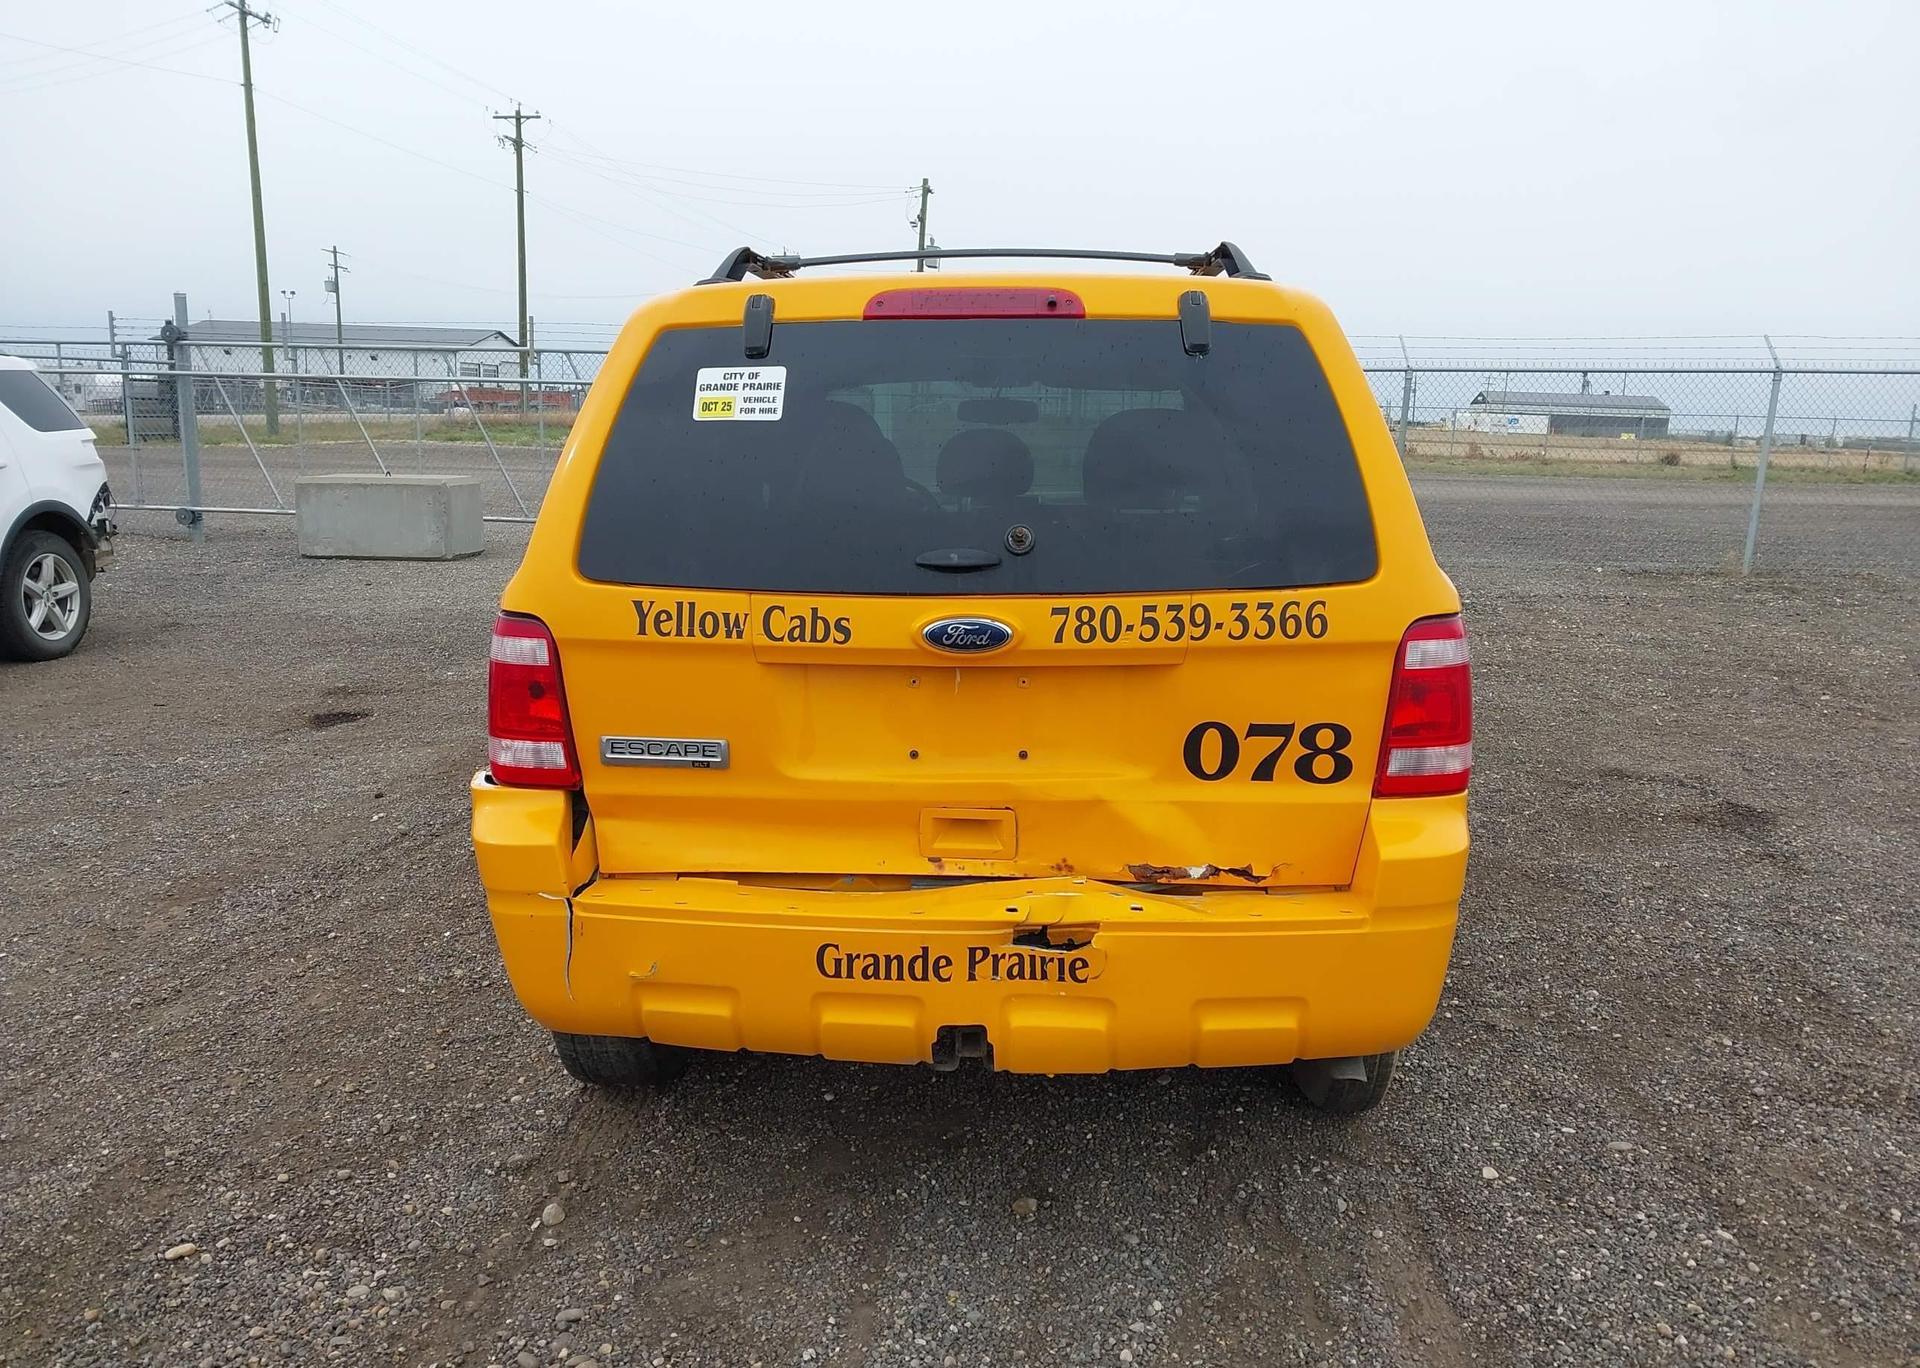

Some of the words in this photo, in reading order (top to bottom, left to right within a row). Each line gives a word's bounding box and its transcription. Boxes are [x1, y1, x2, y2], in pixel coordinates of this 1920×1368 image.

[723, 372, 745, 381] CITY
[748, 371, 761, 380] OF
[699, 383, 740, 392] GRANDE
[742, 382, 782, 391] PRAIRIE
[701, 402, 719, 412] OCT
[720, 401, 733, 412] 25
[743, 396, 777, 404] VEHICLE
[739, 407, 756, 415] FOR
[758, 407, 779, 415] HIRE
[631, 599, 750, 640] Yellow
[762, 604, 852, 645] Cabs
[1049, 600, 1329, 644] 780-539-3366
[942, 624, 992, 645] Ford
[609, 740, 719, 758] ESCAPE
[1183, 720, 1354, 785] 078
[815, 942, 953, 983] Grande
[966, 945, 1090, 984] Prairie
